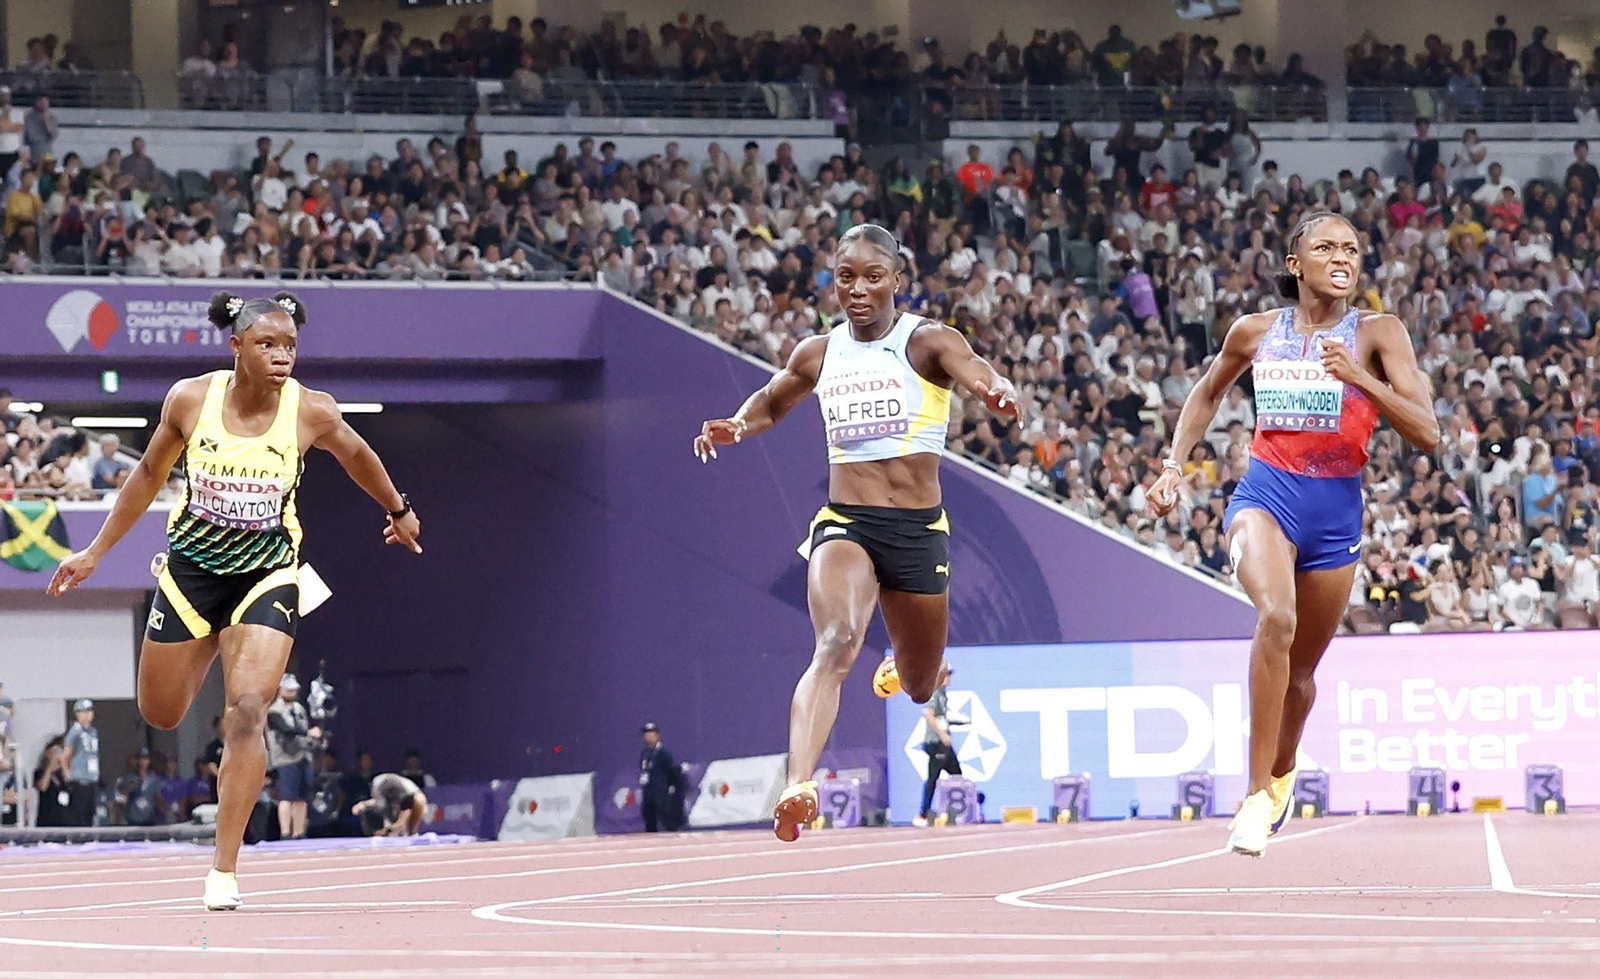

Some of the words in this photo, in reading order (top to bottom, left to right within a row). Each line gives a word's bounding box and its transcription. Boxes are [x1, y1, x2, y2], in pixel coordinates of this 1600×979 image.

[822, 378, 903, 399] HONDA
[828, 398, 901, 426] ALFRED
[194, 472, 280, 494] HONDA
[211, 495, 278, 518] CLAYTON
[1337, 679, 1389, 725] In
[1401, 671, 1600, 732] Everyt
[1338, 727, 1530, 773] Better
[1058, 783, 1083, 808] 7
[1184, 780, 1207, 808] 6
[1301, 778, 1321, 805] 5
[1416, 775, 1438, 799] 4
[1533, 773, 1555, 800] 3
[830, 790, 850, 818] 9
[947, 787, 967, 815] 8
